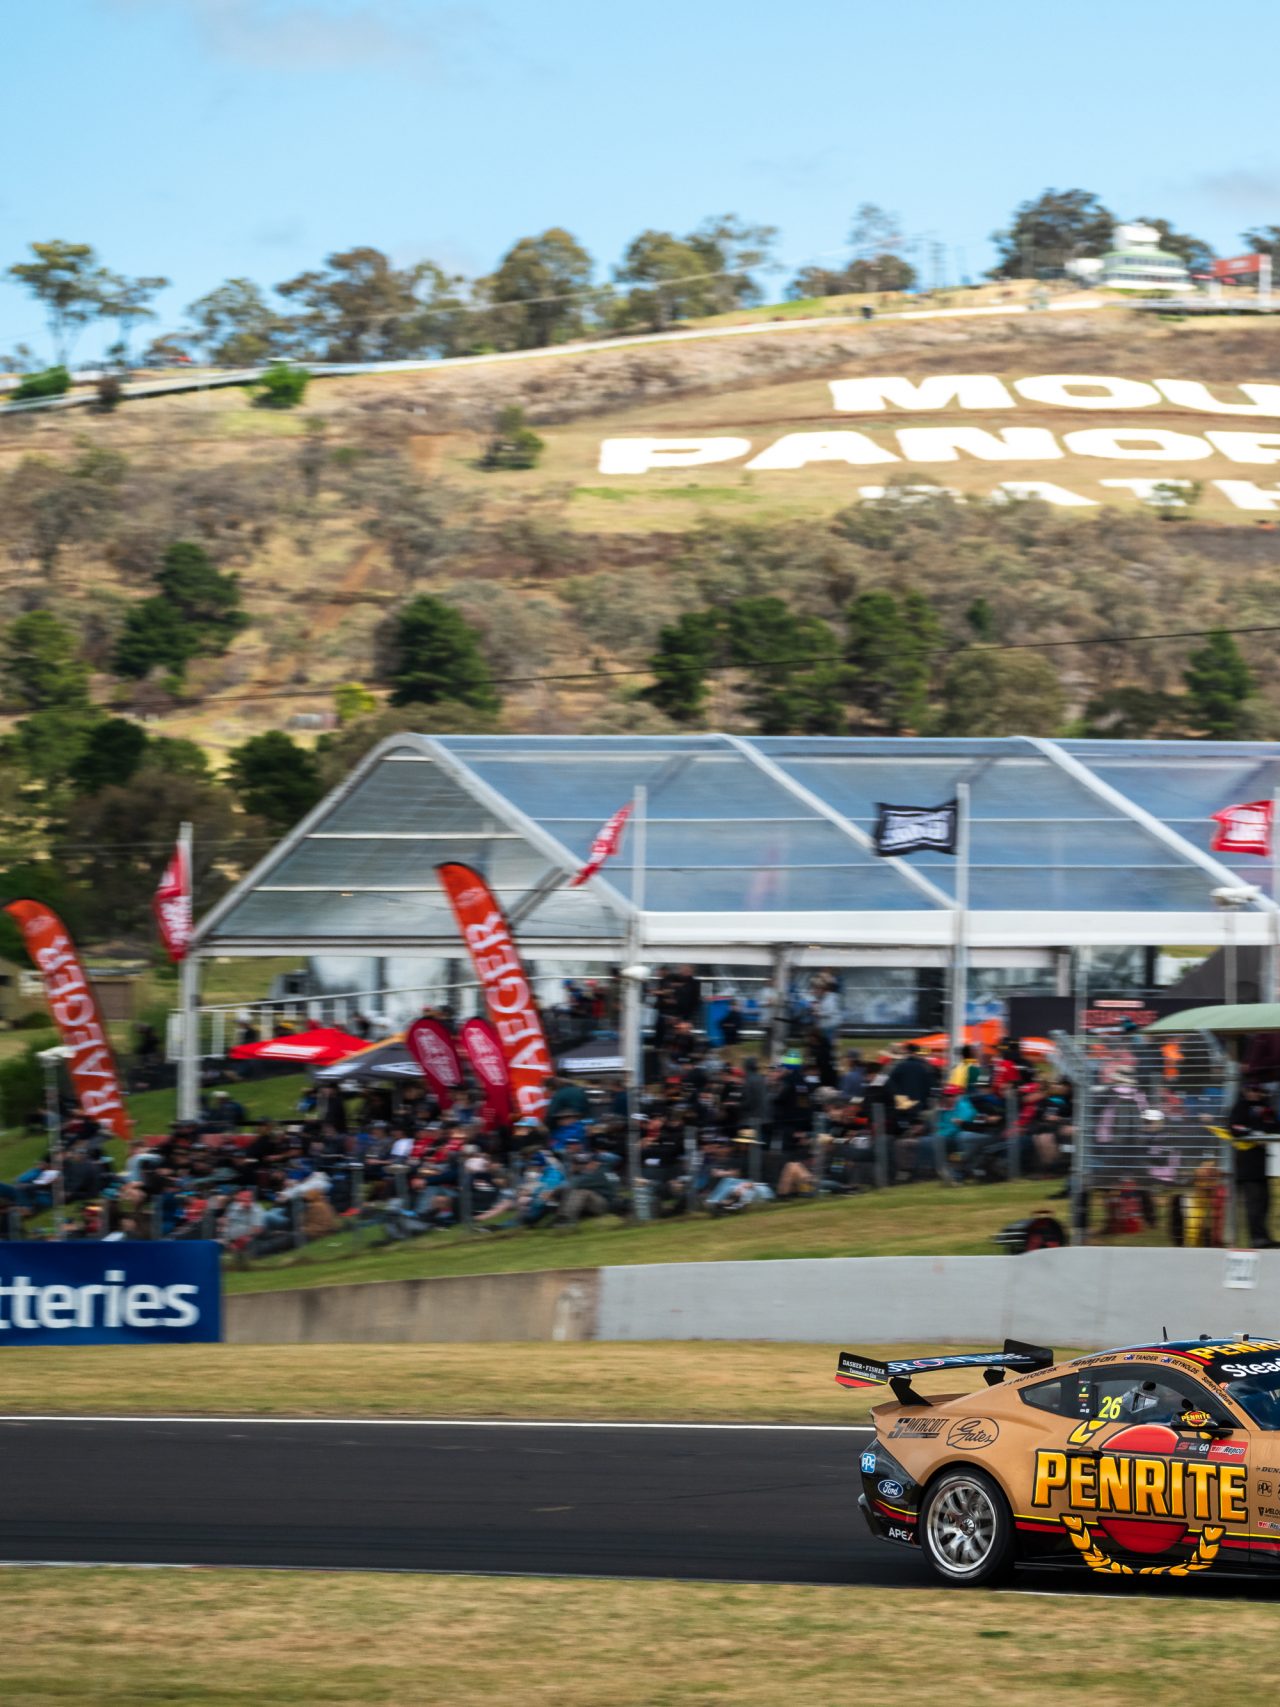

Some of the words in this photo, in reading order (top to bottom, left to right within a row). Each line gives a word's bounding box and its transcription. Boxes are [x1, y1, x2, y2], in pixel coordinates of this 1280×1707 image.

[466, 911, 551, 1114] RAEGER
[865, 1365, 885, 1375] FISHER
[1171, 1359, 1200, 1375] REYNOLDS
[1098, 1396, 1124, 1420] 26
[1180, 1411, 1212, 1423] PENRITE
[957, 1420, 994, 1444] Gates
[882, 1481, 899, 1496] Ford
[1032, 1449, 1248, 1523] PENRITE
[888, 1527, 914, 1541] APEX
